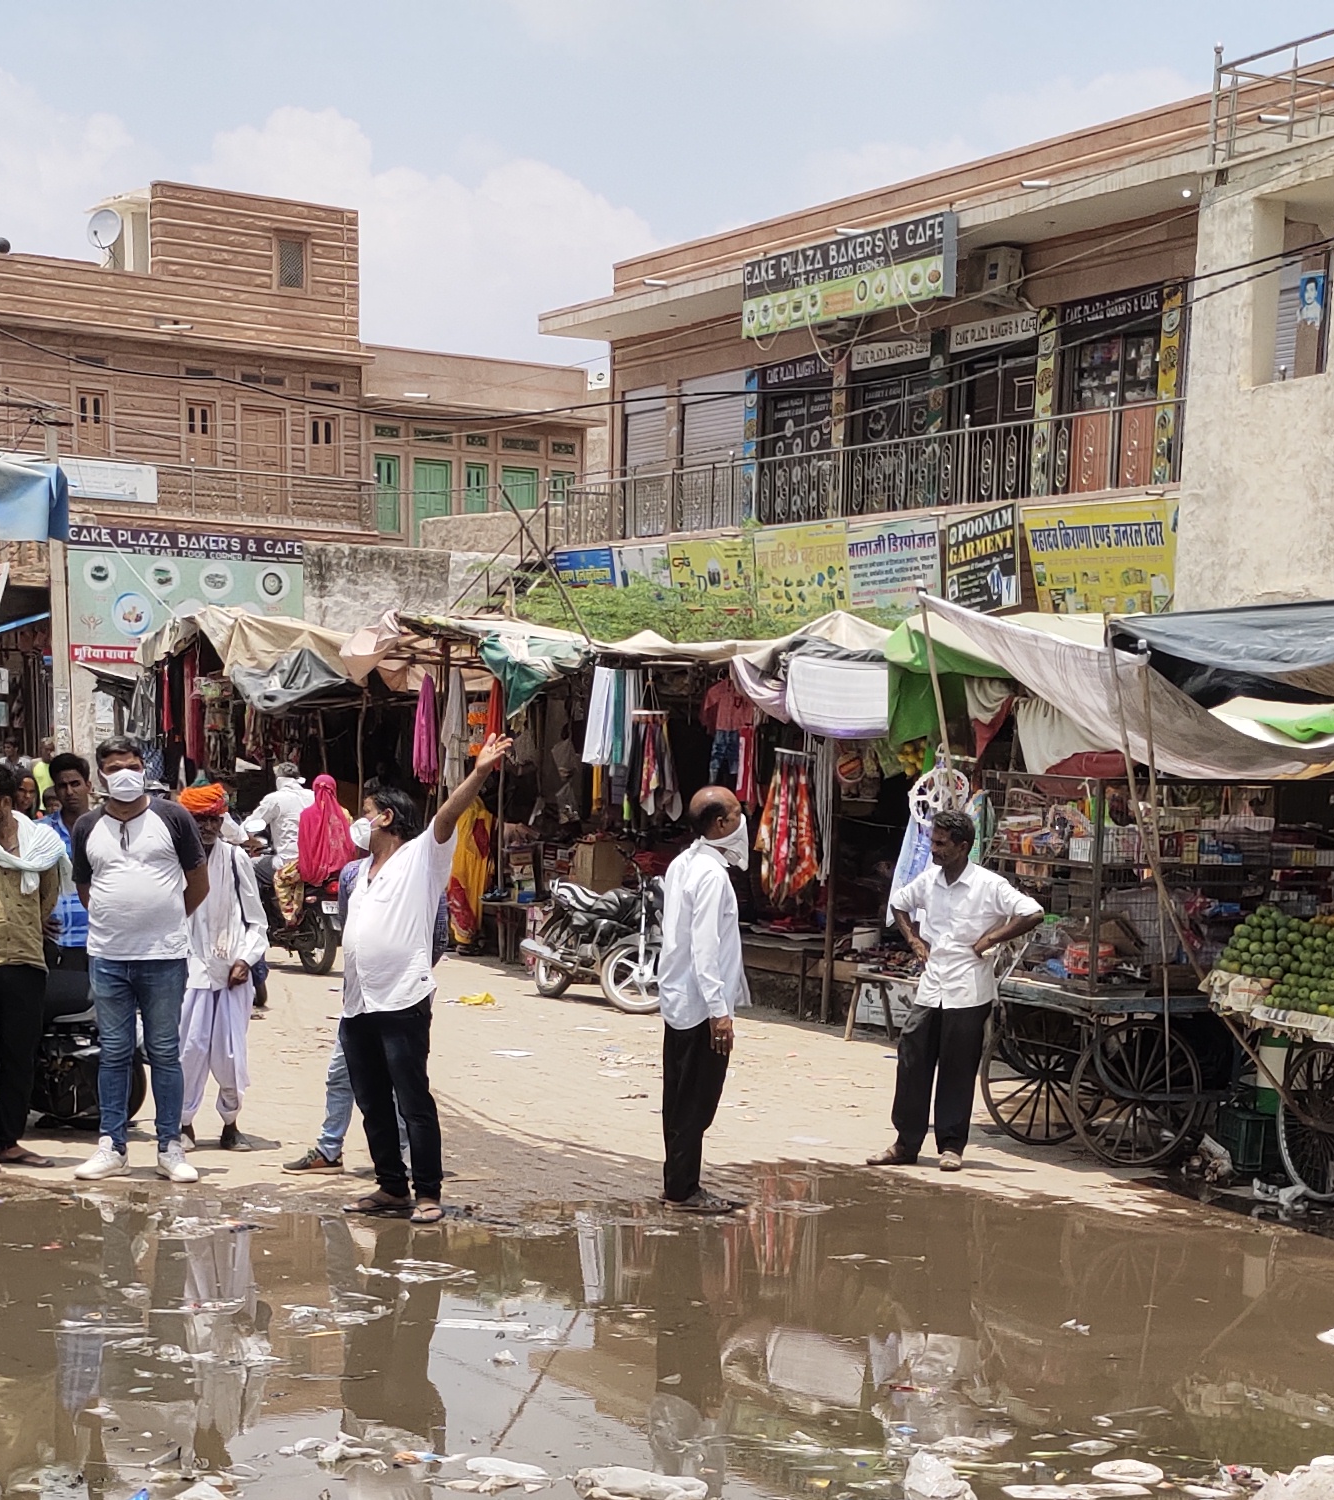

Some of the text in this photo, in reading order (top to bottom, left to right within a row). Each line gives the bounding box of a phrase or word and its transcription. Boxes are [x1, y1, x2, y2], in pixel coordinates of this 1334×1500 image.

[744, 260, 777, 286] CAKE
[781, 249, 823, 278] PLAZA
[890, 229, 899, 250] &
[905, 216, 943, 246] CAFE
[832, 264, 853, 279] FOOD
[856, 257, 885, 273] CORNER
[958, 507, 1013, 542] POONAM
[1030, 513, 1165, 552] महादेव किराणा एण्ड जनरल स्टोर
[69, 527, 303, 555] CAKE PLAZA BAKER'S & CAFE
[135, 546, 151, 555] THE
[155, 547, 178, 557] FAST
[182, 550, 206, 559] FOOD
[210, 551, 242, 561] CORNER
[848, 533, 886, 558] बालाजी
[949, 529, 1013, 565] GARMENT
